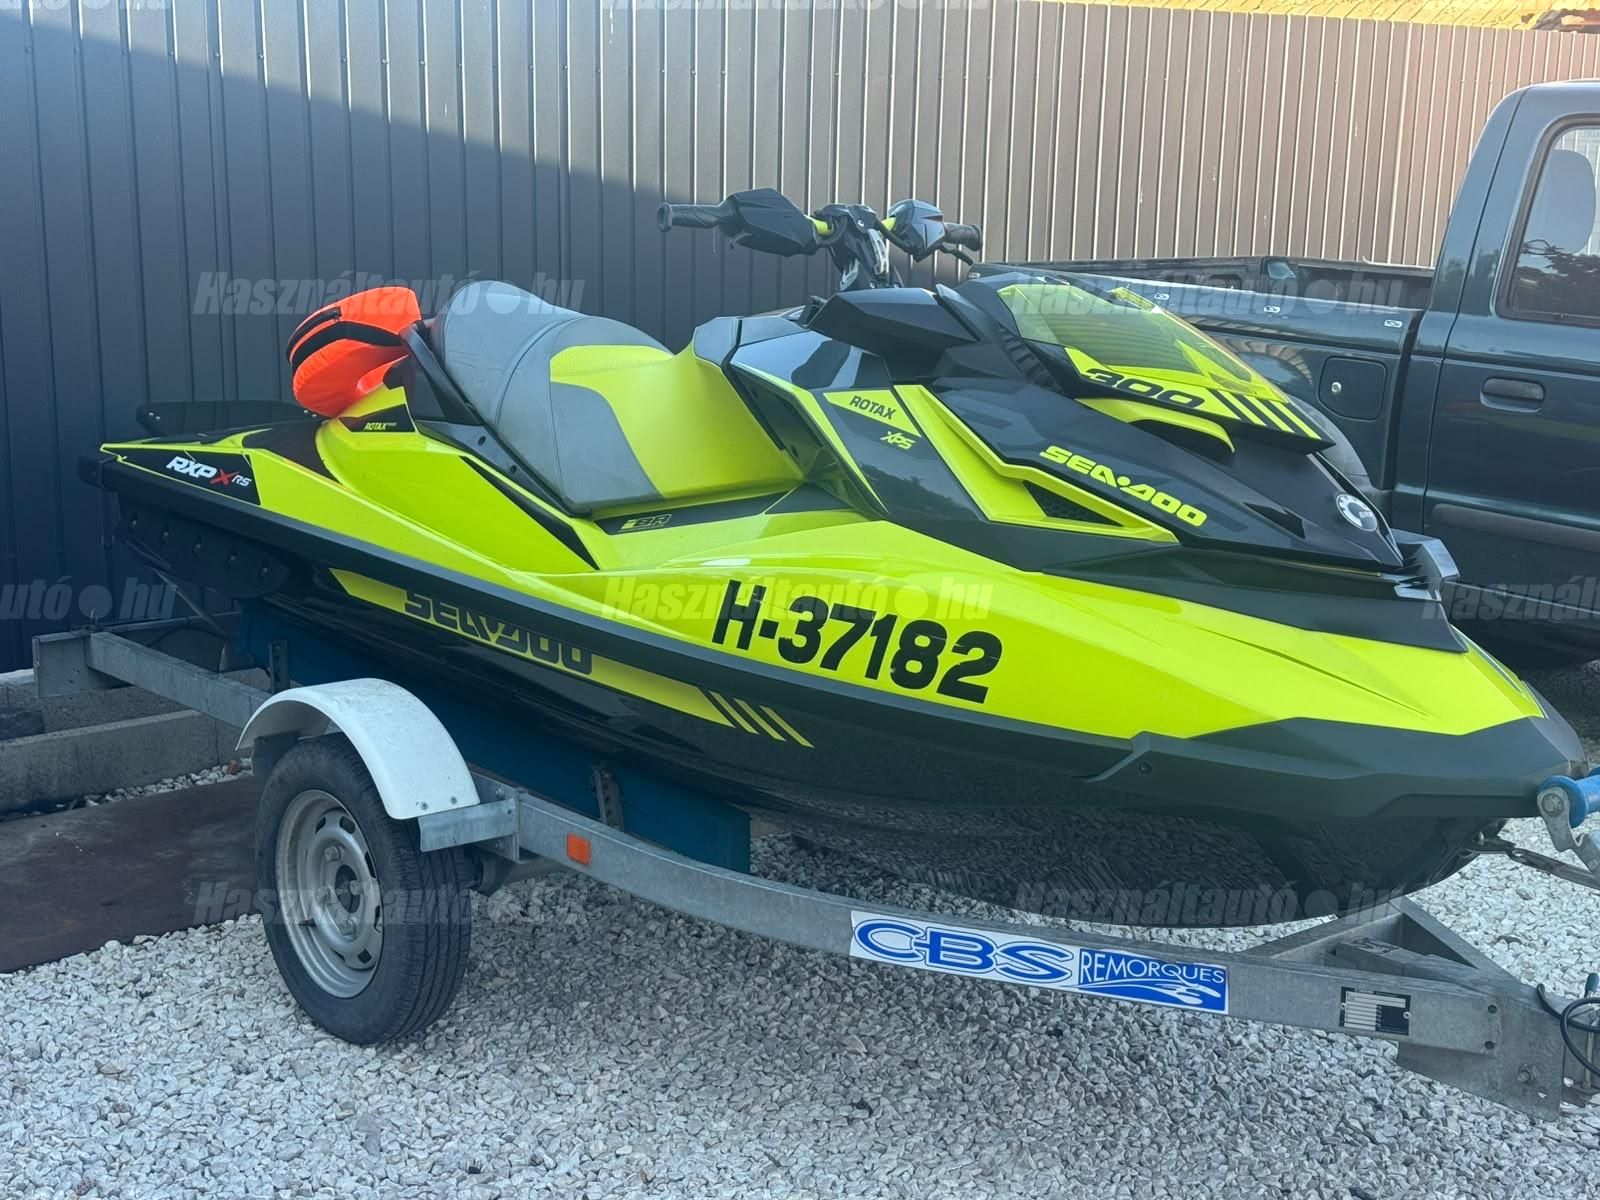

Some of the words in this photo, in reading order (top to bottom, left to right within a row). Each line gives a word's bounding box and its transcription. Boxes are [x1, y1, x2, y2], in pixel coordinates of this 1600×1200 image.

[1080, 368, 1206, 409] 300
[849, 395, 897, 420] ROTAX
[363, 422, 387, 431] ROTAX
[880, 431, 916, 450] XPS
[712, 579, 1003, 705] H-37182
[854, 919, 1075, 983] CBS
[1079, 951, 1226, 988] REMORQUES
